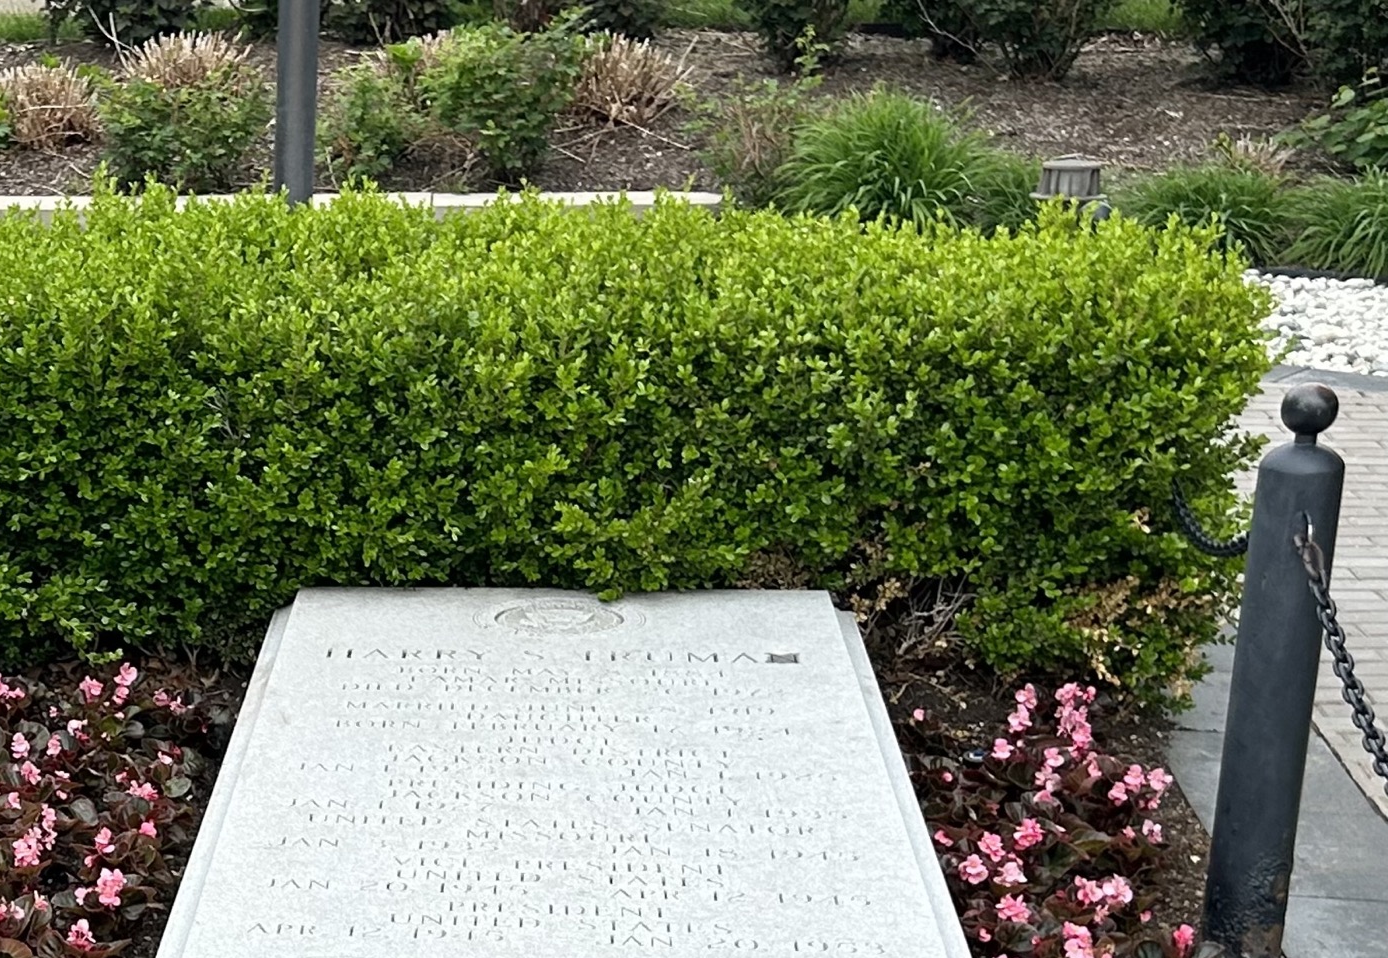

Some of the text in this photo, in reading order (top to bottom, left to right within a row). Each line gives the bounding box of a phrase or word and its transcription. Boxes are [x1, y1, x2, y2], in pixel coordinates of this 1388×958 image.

[326, 648, 491, 659] HARRY
[576, 650, 801, 663] TRUMAN
[336, 720, 420, 728] BORN
[307, 813, 442, 826] UNITED
[466, 829, 649, 843] MISSOURI
[514, 859, 730, 874] PRESIDENT
[396, 869, 724, 887] UNITED STATES
[448, 901, 670, 918] PRESIDENT
[390, 913, 732, 933] UNITED STATES
